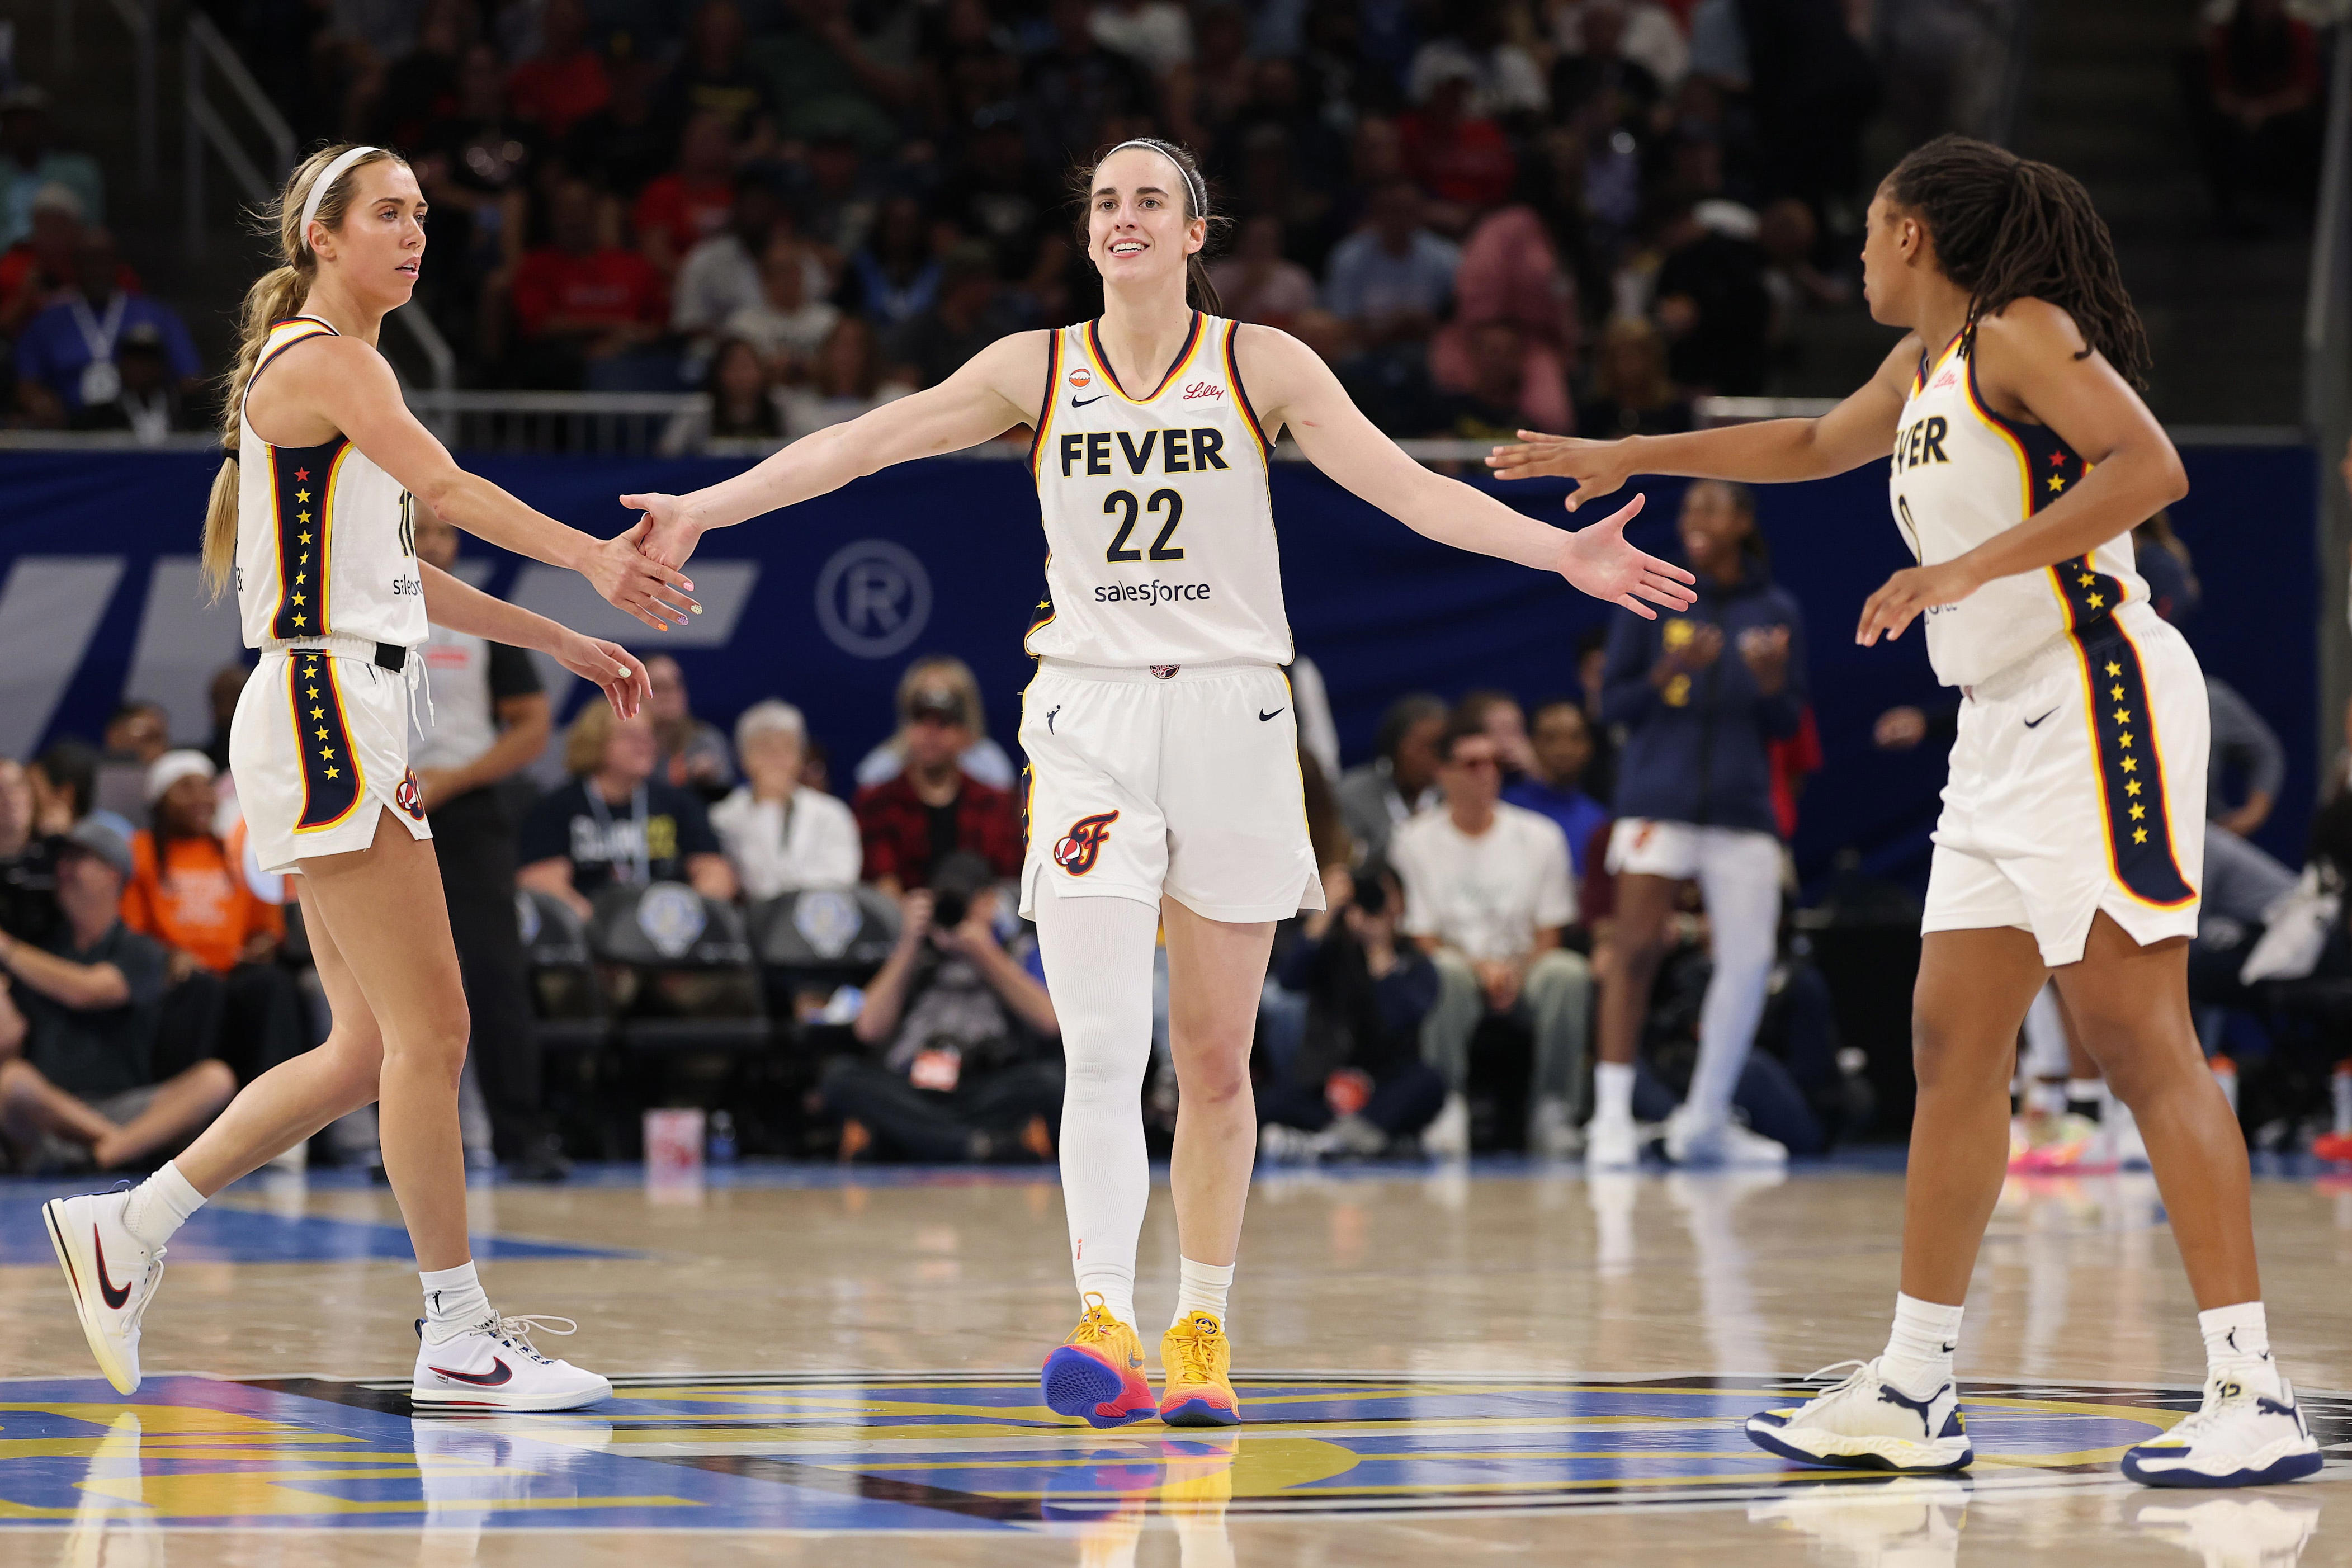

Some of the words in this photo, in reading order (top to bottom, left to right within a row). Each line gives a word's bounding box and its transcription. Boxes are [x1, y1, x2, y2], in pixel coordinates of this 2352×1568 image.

[1183, 382, 1225, 401] Lilly
[1061, 427, 1231, 478] FEVER
[1894, 416, 1952, 475] VER
[1103, 488, 1186, 564] 22
[1095, 579, 1211, 606] salesforce
